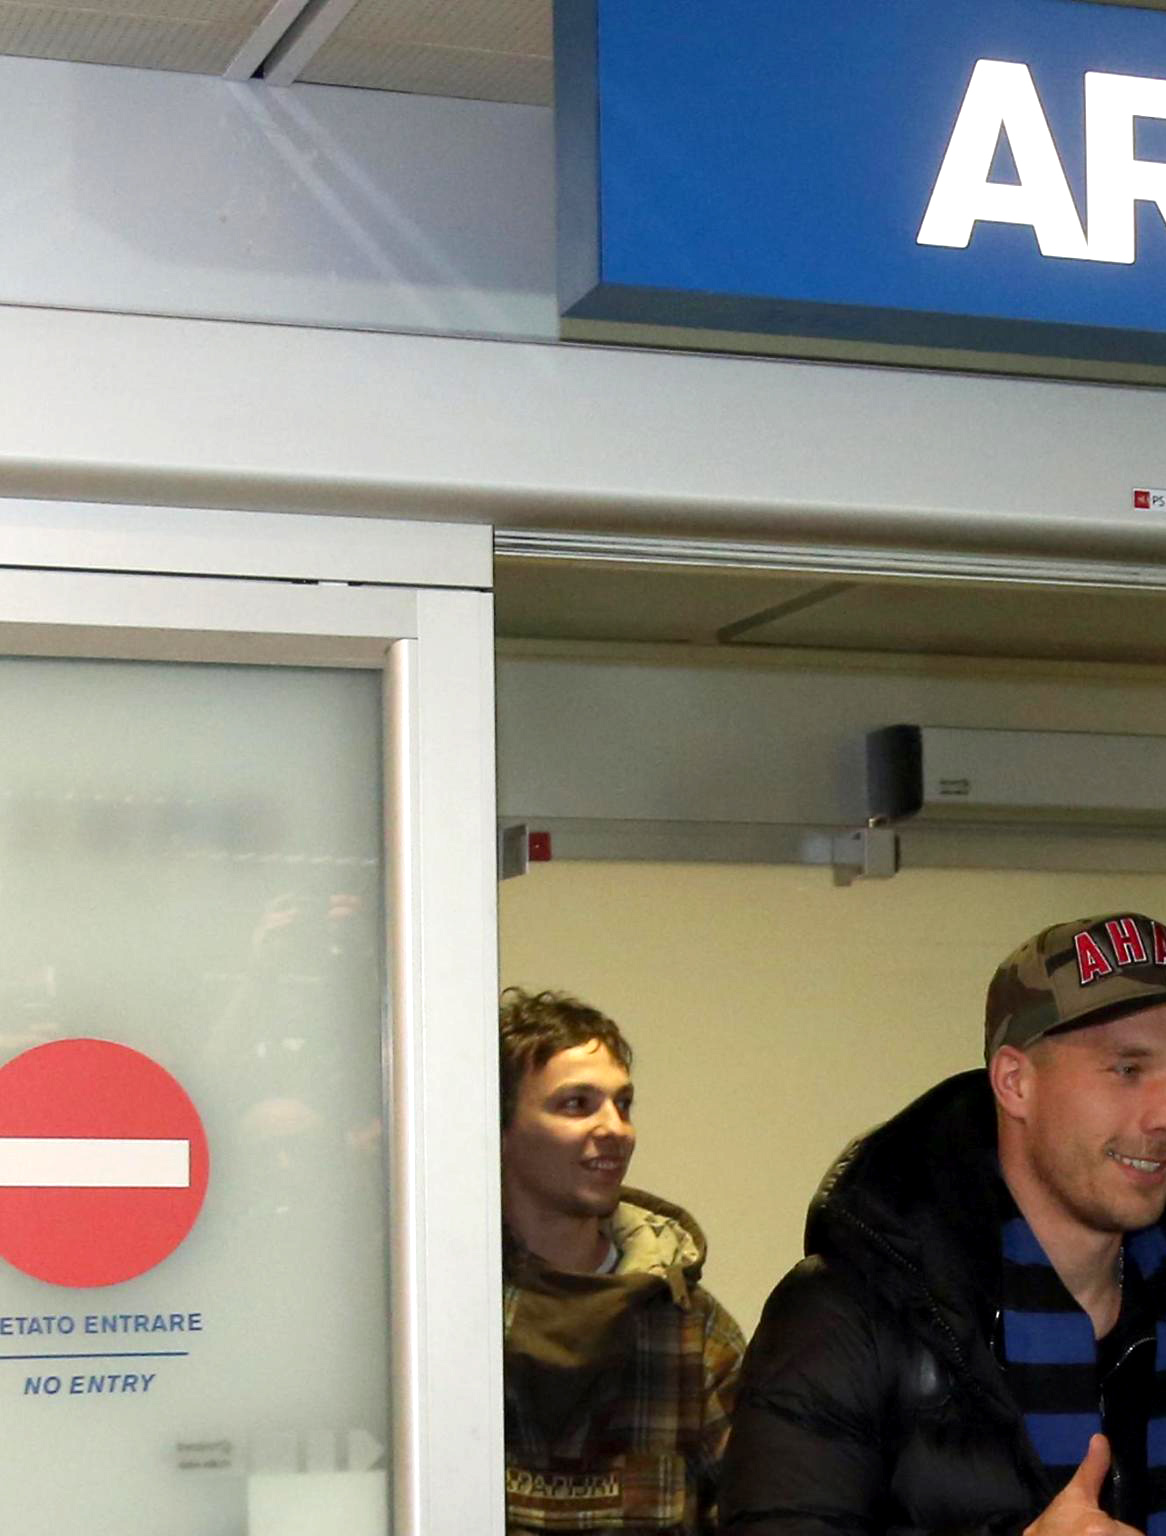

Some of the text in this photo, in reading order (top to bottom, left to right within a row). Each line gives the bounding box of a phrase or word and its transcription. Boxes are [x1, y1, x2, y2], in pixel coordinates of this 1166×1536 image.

[1152, 495, 1165, 507] PS
[84, 1313, 203, 1335] ENTRARE
[24, 1373, 156, 1396] NO ENTRY
